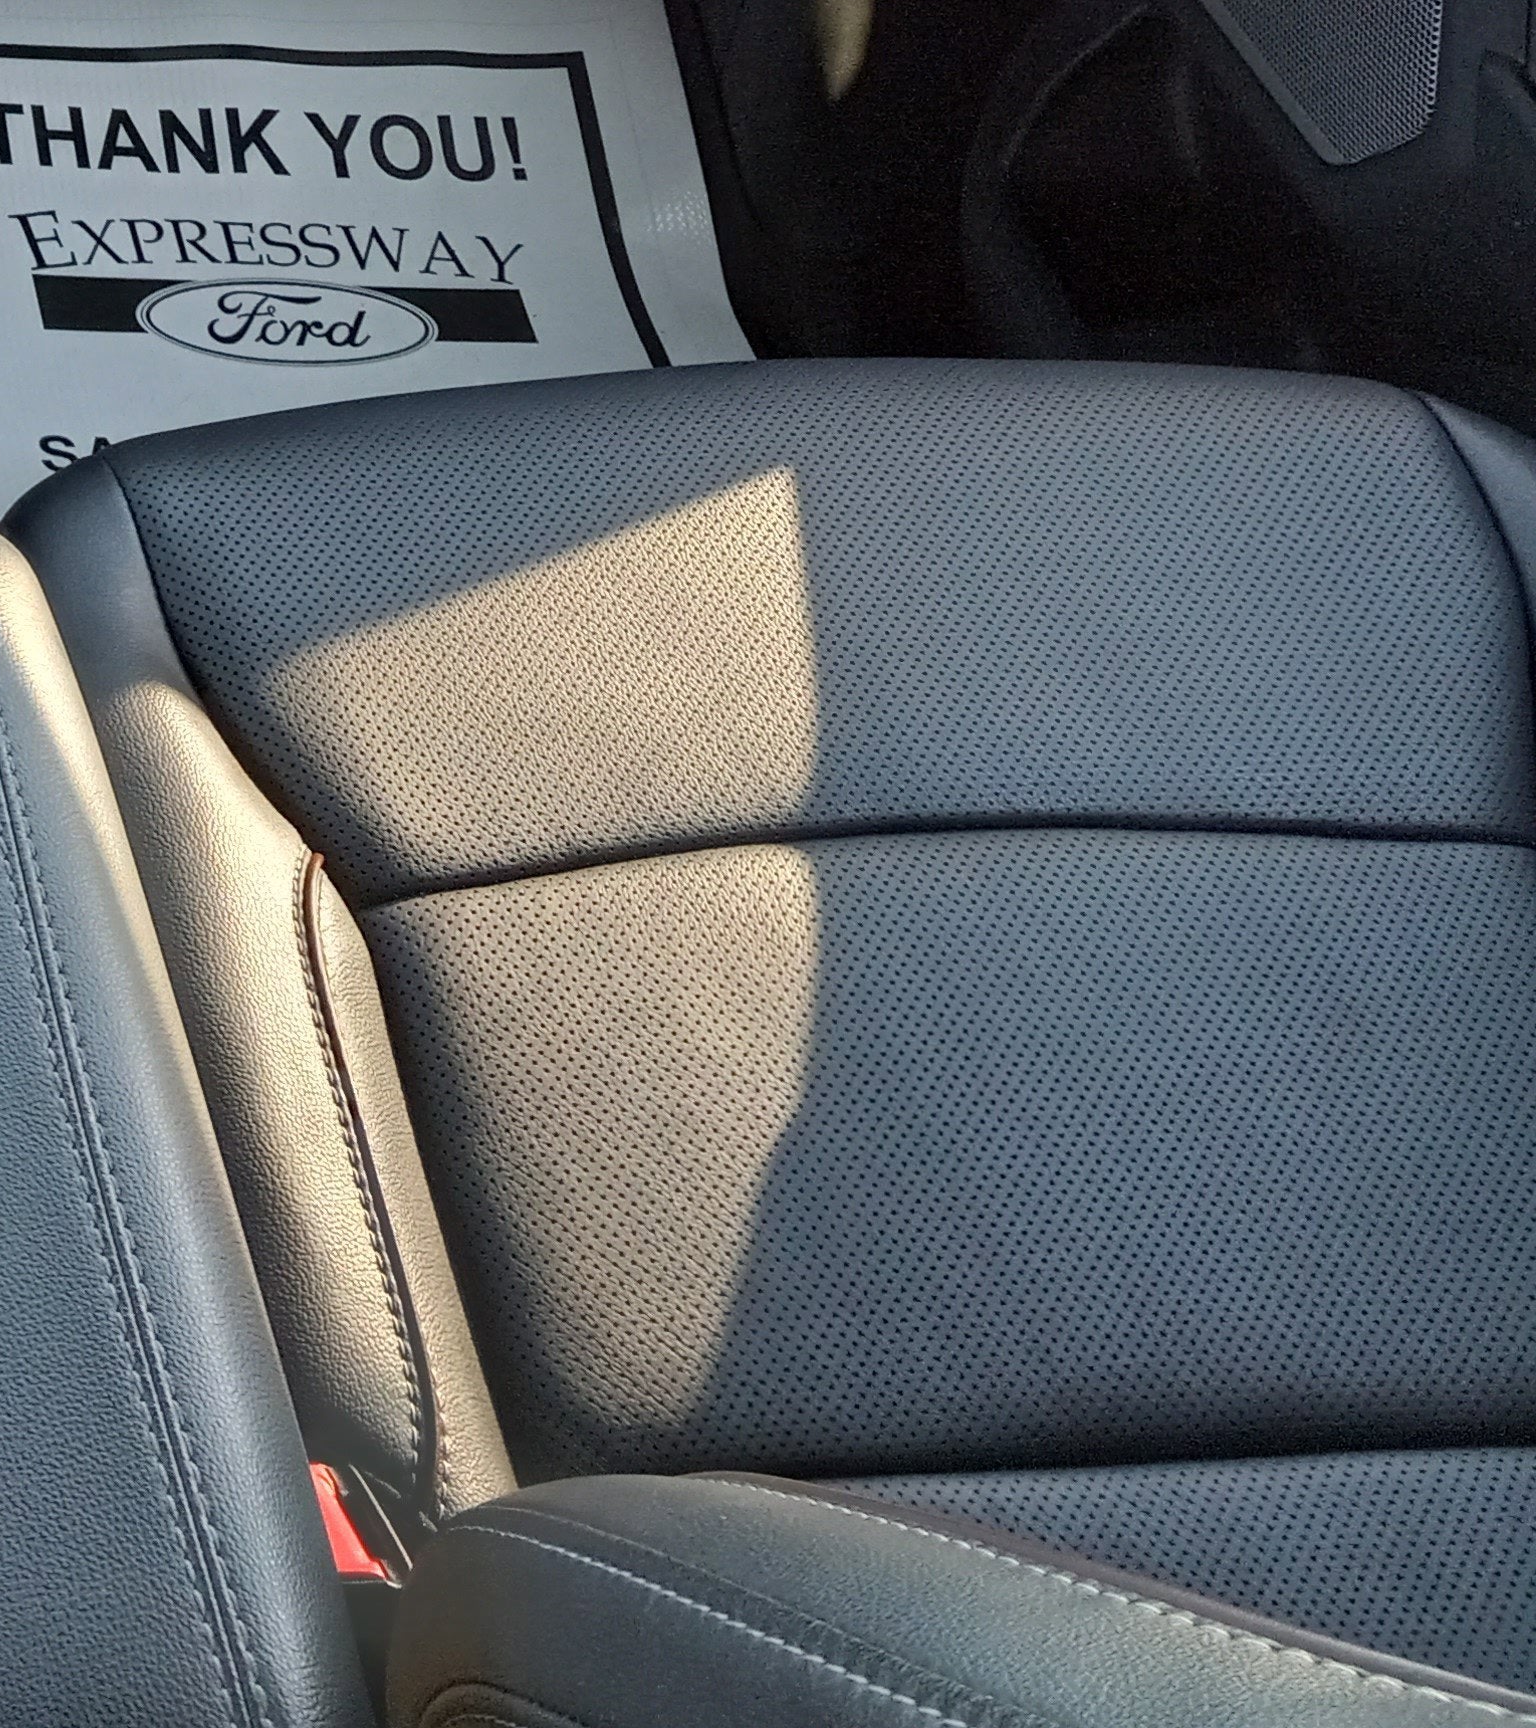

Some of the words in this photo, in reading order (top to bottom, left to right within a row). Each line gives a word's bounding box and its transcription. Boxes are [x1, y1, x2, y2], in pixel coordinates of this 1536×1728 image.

[305, 112, 528, 182] YOU!
[8, 209, 525, 285] EXPRESSWAY
[207, 288, 372, 351] Ford
